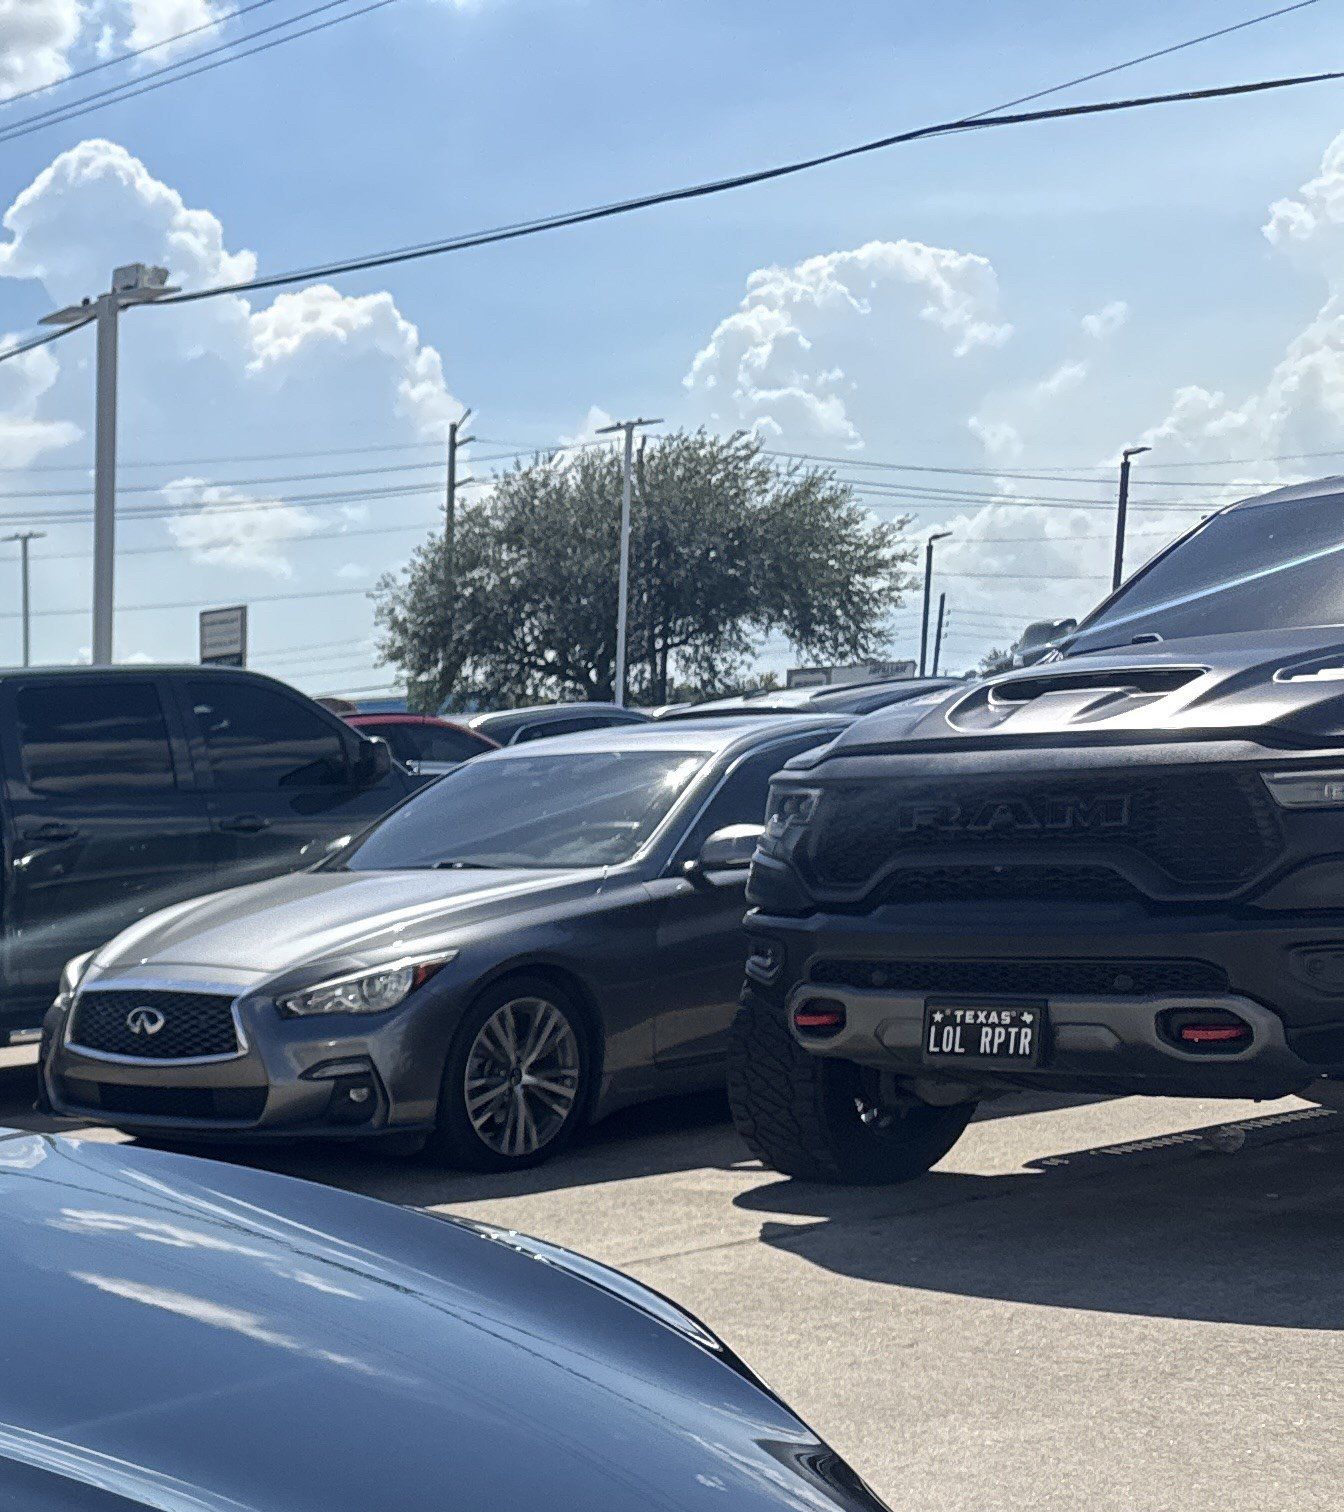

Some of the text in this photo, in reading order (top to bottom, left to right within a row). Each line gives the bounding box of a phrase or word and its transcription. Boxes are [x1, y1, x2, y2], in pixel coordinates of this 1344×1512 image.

[897, 793, 1132, 832] RAM
[954, 1010, 1012, 1024] TEXAS
[929, 1025, 1032, 1055] LOL RPTR
